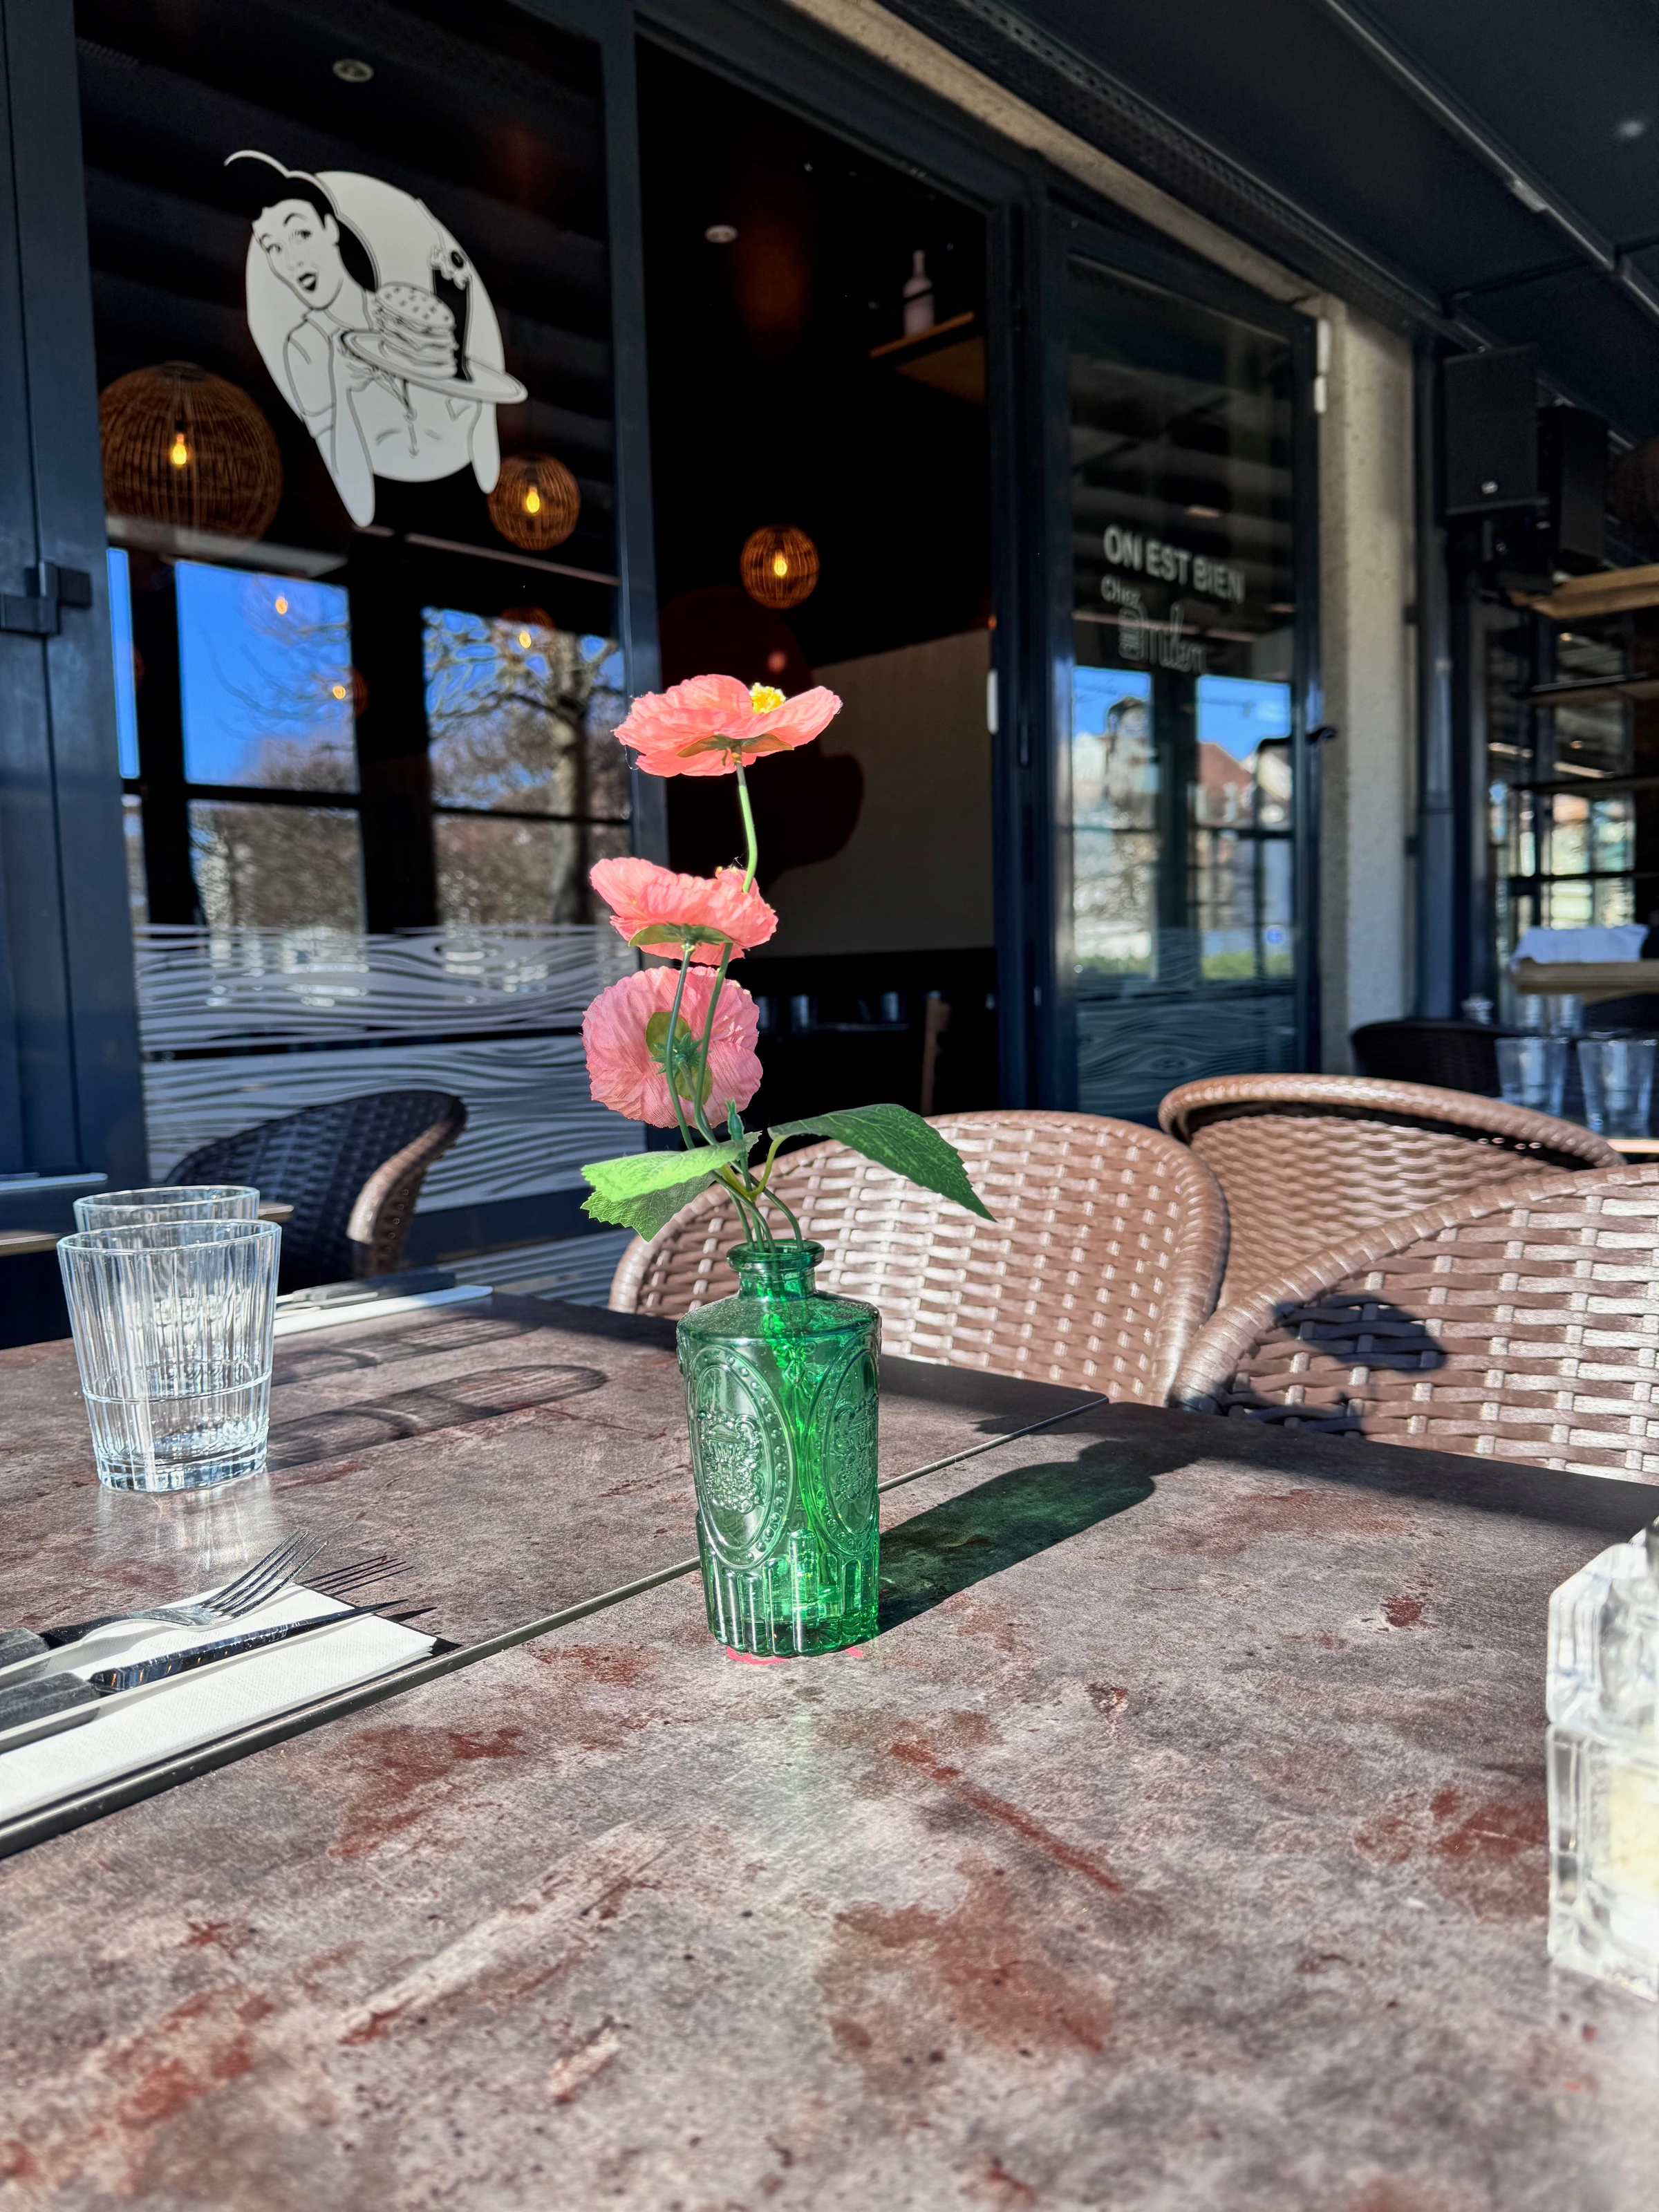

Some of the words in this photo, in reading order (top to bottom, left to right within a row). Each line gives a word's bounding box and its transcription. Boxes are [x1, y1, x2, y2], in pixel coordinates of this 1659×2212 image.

[1104, 525, 1143, 571] ON
[1145, 538, 1192, 585] EST
[1193, 555, 1245, 604] BIEN
